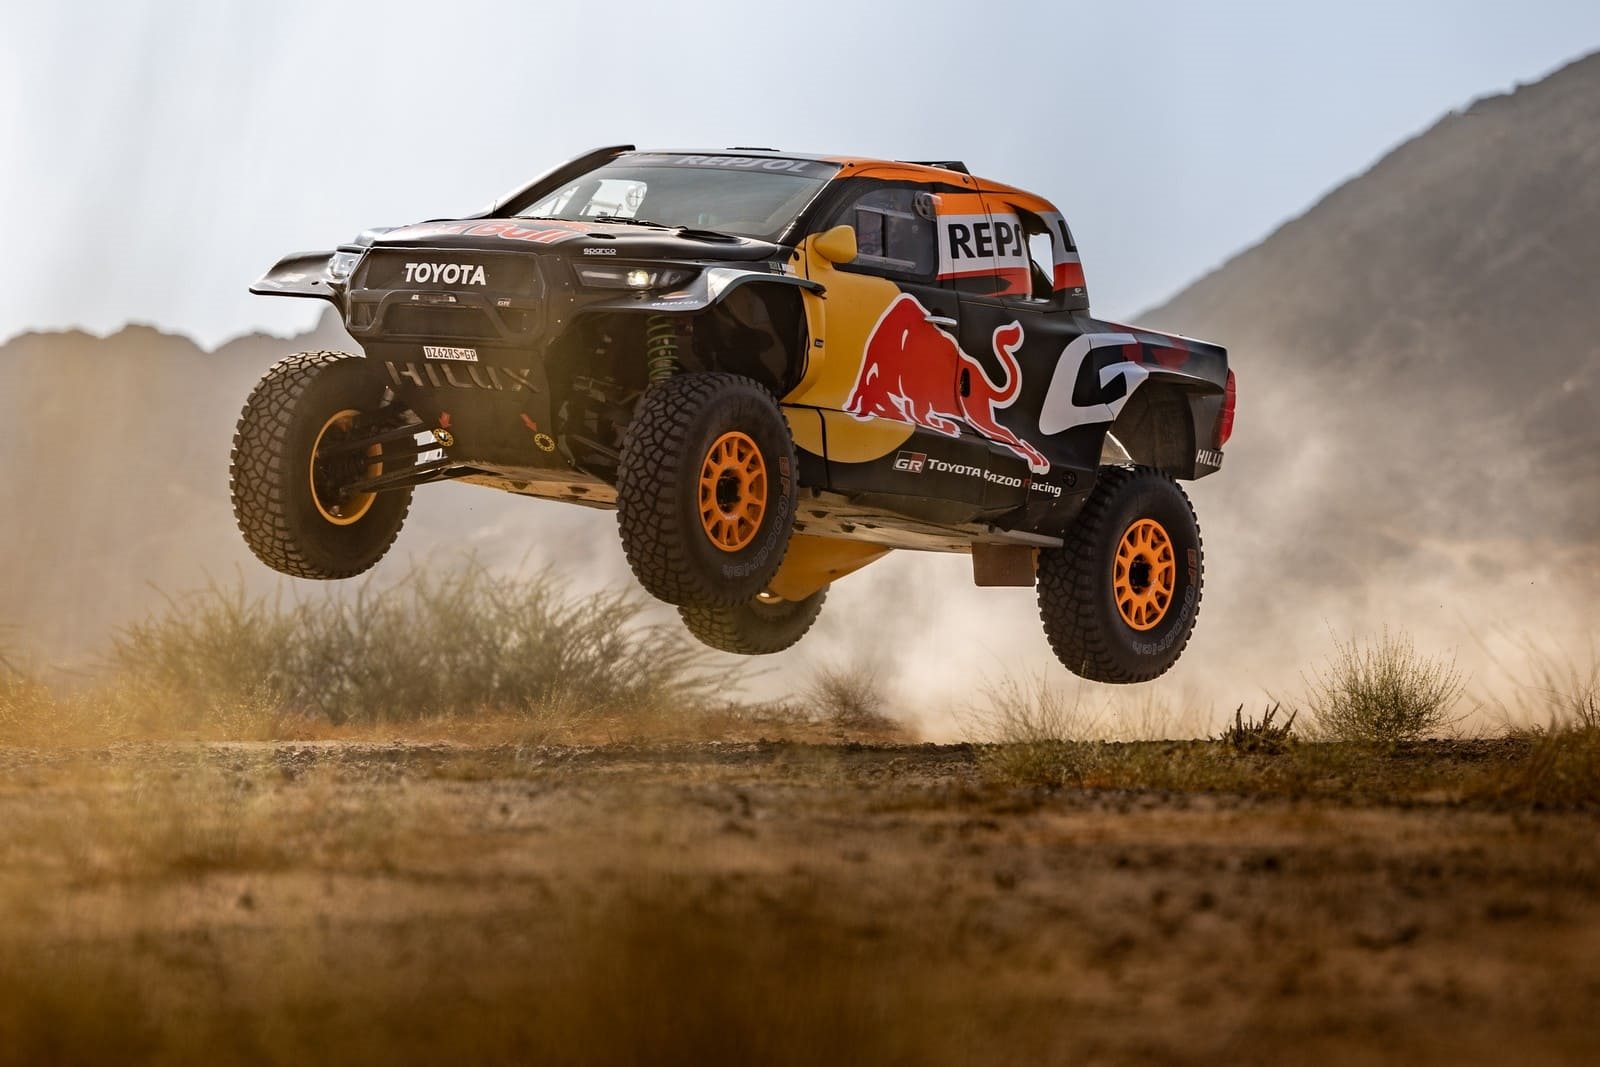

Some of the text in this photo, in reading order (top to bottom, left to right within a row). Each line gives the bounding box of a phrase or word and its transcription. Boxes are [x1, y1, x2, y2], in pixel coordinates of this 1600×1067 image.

[674, 155, 810, 173] REPSOL
[947, 220, 1078, 260] REPSL
[583, 248, 616, 256] sparco
[405, 262, 487, 286] TOYOTA
[425, 347, 477, 361] DZ62RS GP
[384, 361, 541, 393] HILUX
[895, 458, 923, 472] GR
[927, 458, 981, 478] TOYOTA
